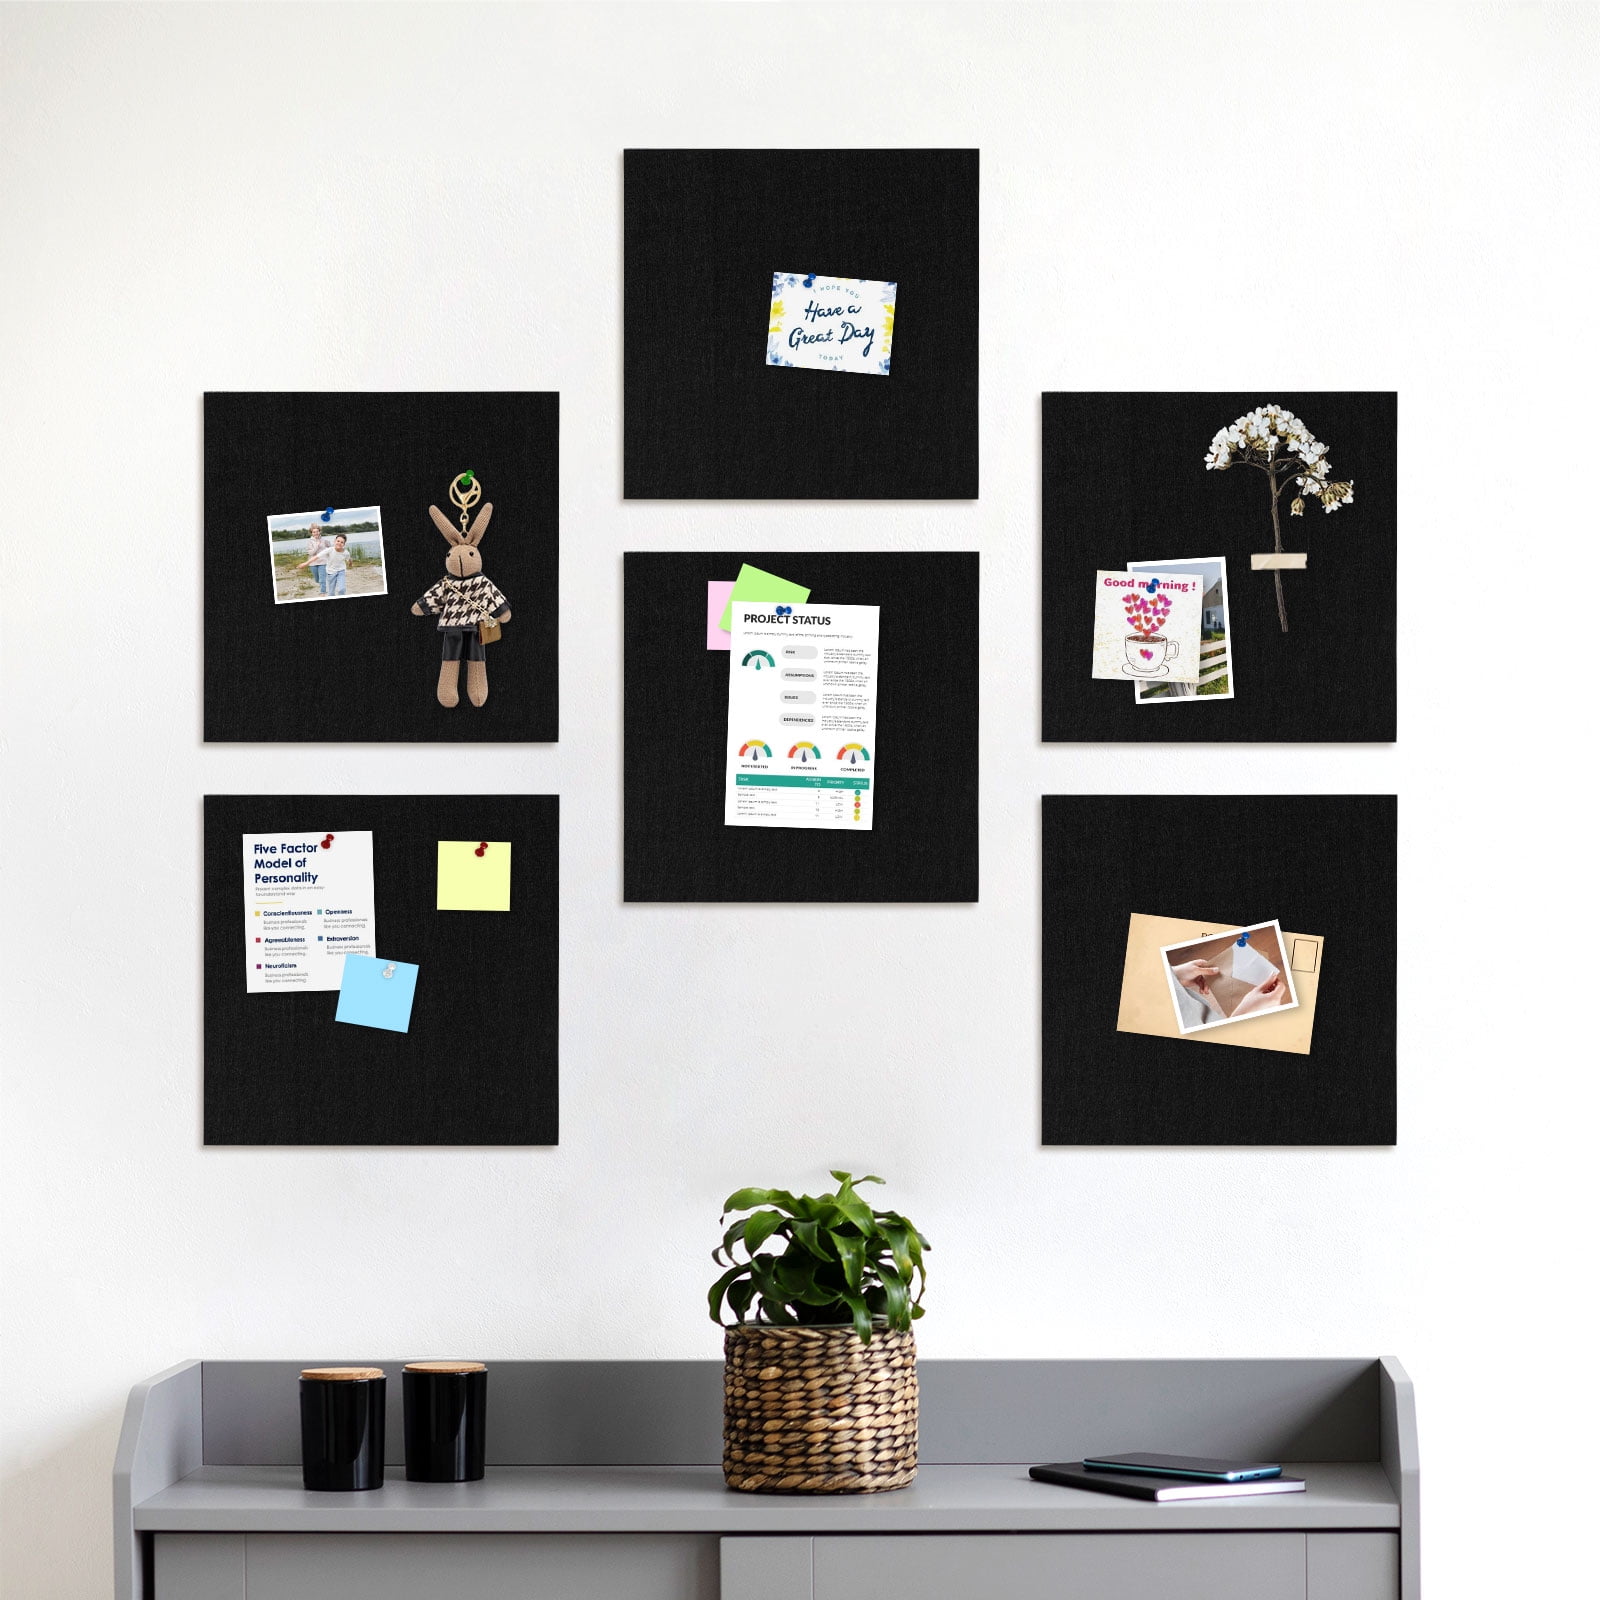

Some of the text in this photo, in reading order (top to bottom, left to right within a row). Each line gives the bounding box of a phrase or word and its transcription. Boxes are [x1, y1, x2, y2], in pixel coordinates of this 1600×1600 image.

[845, 288, 859, 299] YOU
[804, 299, 862, 323] Have a
[788, 320, 875, 358] Great Day
[1103, 577, 1135, 588] Good
[1137, 579, 1189, 593] mrning
[743, 613, 832, 626] PROJECT STATUS
[254, 842, 318, 854] Five Factor
[254, 857, 307, 869] Model of
[254, 871, 319, 885] Personality
